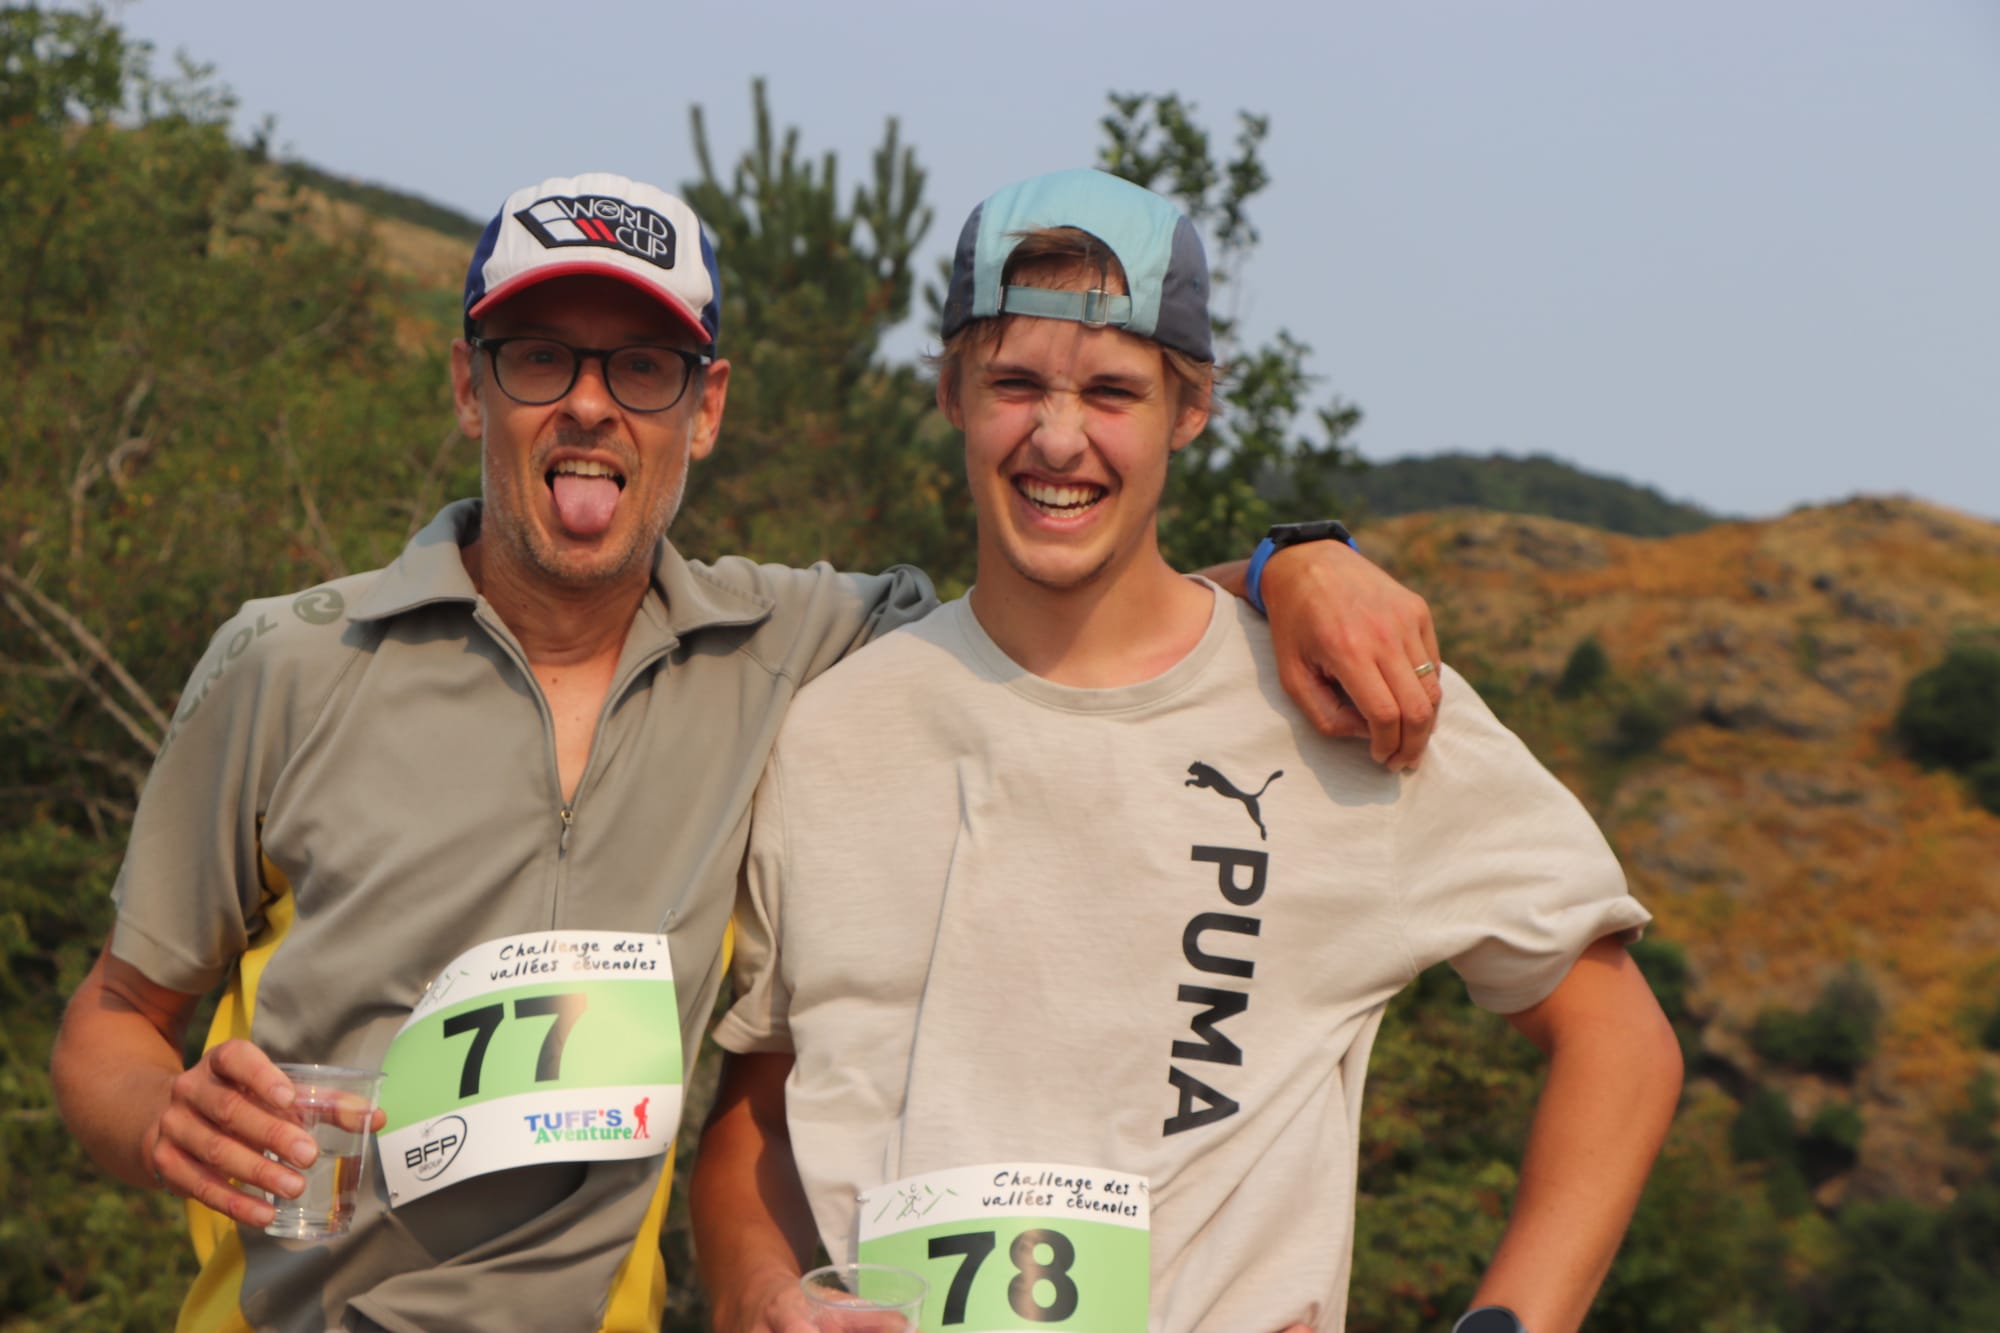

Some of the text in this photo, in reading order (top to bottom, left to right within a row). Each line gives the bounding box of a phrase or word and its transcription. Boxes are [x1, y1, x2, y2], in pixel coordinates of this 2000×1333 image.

[557, 198, 668, 239] WORLD
[615, 226, 668, 259] CUP
[499, 939, 645, 961] Challenge des
[490, 955, 657, 981] vallées cévenoles
[1162, 845, 1269, 1137] PUMA
[443, 992, 588, 1100] 77
[524, 1109, 623, 1132] TUFF'S
[534, 1125, 633, 1144] Aventure
[404, 1134, 458, 1169] BFP
[993, 1171, 1129, 1196] Challenge des
[982, 1190, 1139, 1217] vallées cévenoles
[928, 1228, 1078, 1326] 78
